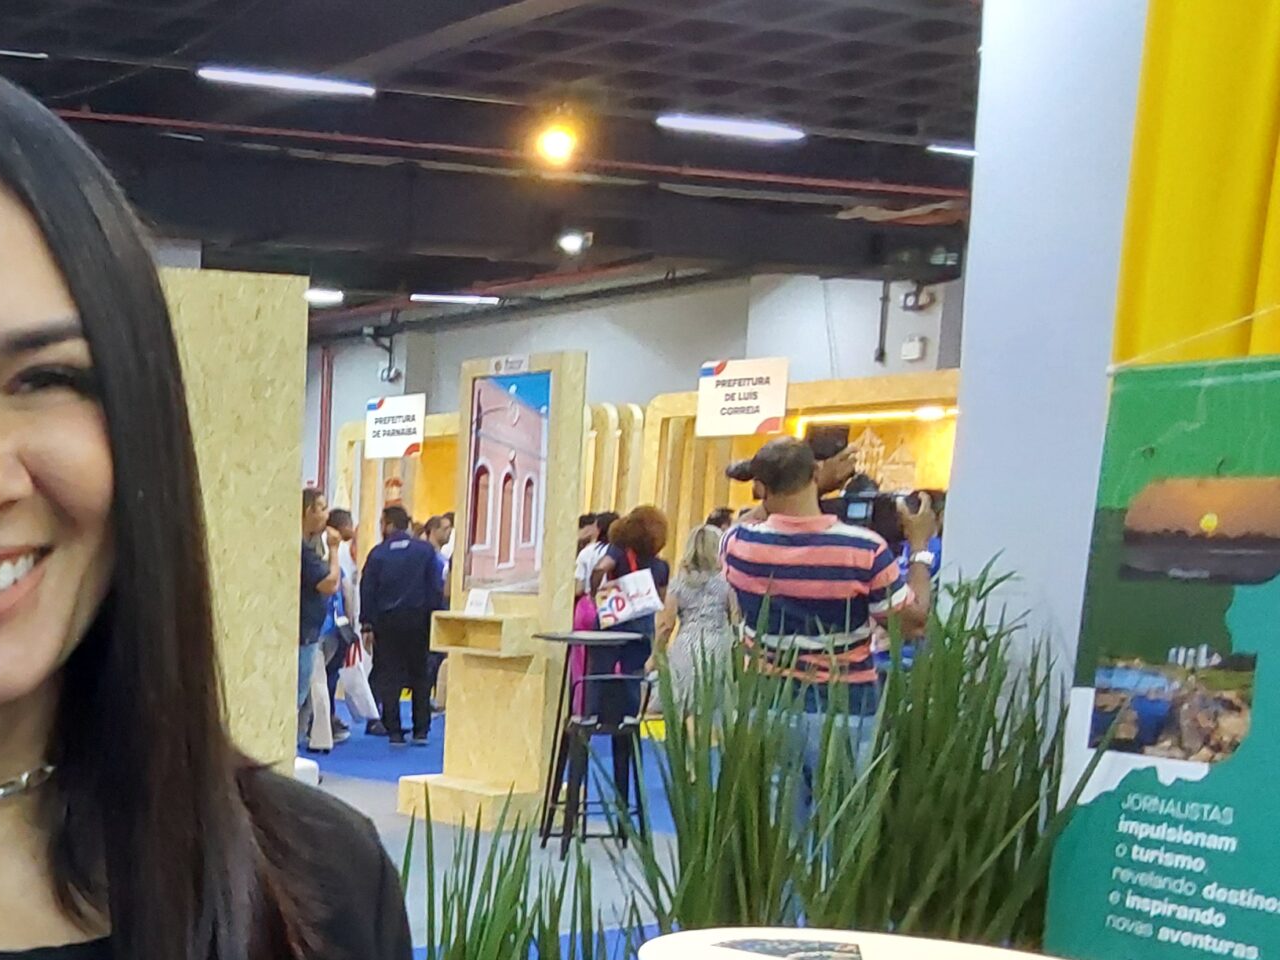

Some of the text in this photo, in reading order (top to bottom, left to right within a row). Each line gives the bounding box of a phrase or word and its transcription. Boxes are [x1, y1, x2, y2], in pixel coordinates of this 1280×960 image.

[715, 376, 771, 388] PREFEITURA
[724, 392, 736, 402] DE
[720, 405, 760, 416] CORREIA
[374, 414, 416, 425] PREFEITURA
[372, 429, 381, 439] DE
[1121, 793, 1234, 825] JORNALISTAS
[1117, 813, 1238, 852] impulsionam
[1115, 843, 1128, 858] o
[1112, 866, 1197, 896] revelando
[1109, 889, 1226, 928] e inspirando
[1106, 914, 1153, 937] novas
